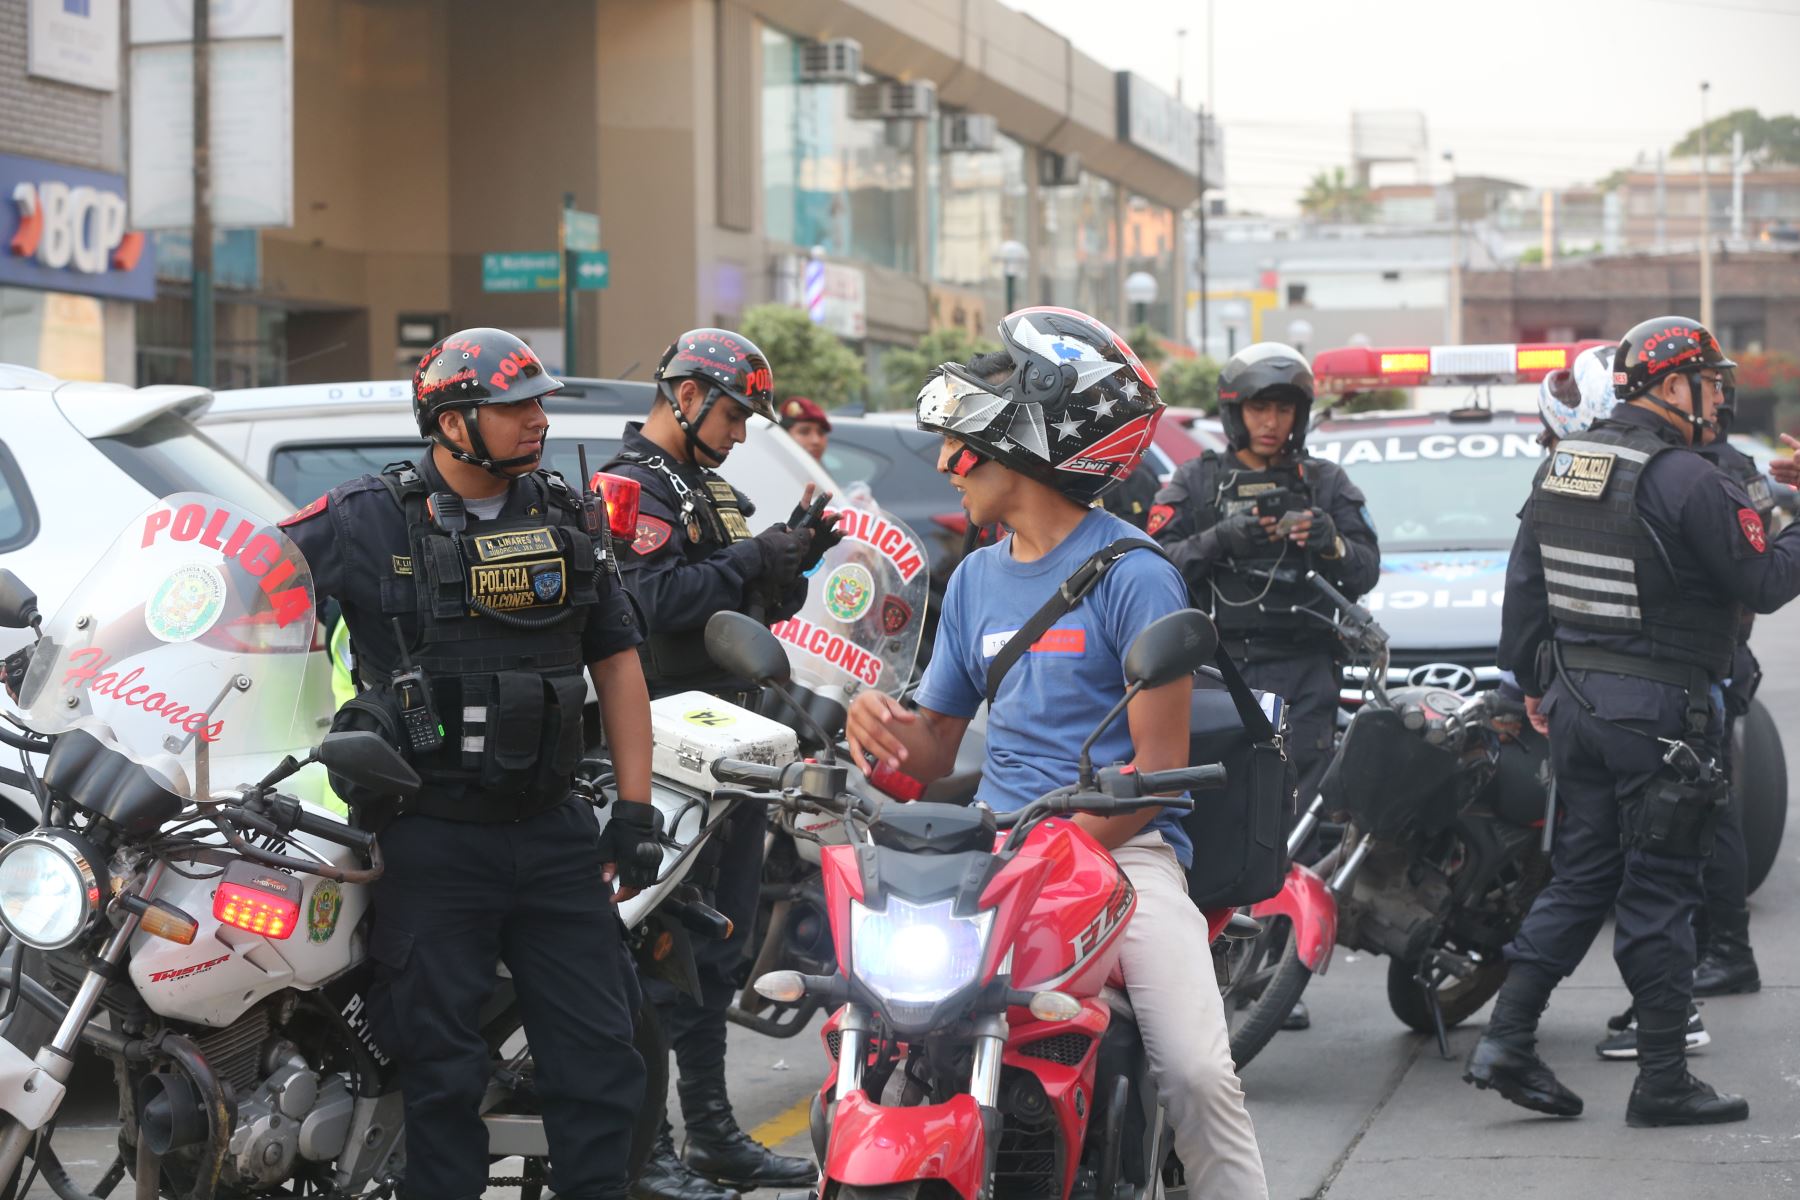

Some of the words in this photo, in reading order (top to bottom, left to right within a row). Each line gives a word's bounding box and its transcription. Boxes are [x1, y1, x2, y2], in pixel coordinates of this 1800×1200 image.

[38, 181, 126, 274] BCP
[684, 333, 747, 362] POLICIA
[1638, 326, 1701, 361] POLICIA
[328, 386, 403, 400] DUS
[1308, 434, 1550, 465] HALCON
[1568, 456, 1607, 480] POLICIA
[1547, 476, 1602, 493] HALCONES
[498, 536, 532, 547] LINARES
[822, 508, 923, 581] OLICIA
[141, 503, 312, 629] POLICIA
[479, 568, 529, 593] POLICIA
[63, 648, 225, 742] Halcones
[149, 954, 231, 982] TWISTER
